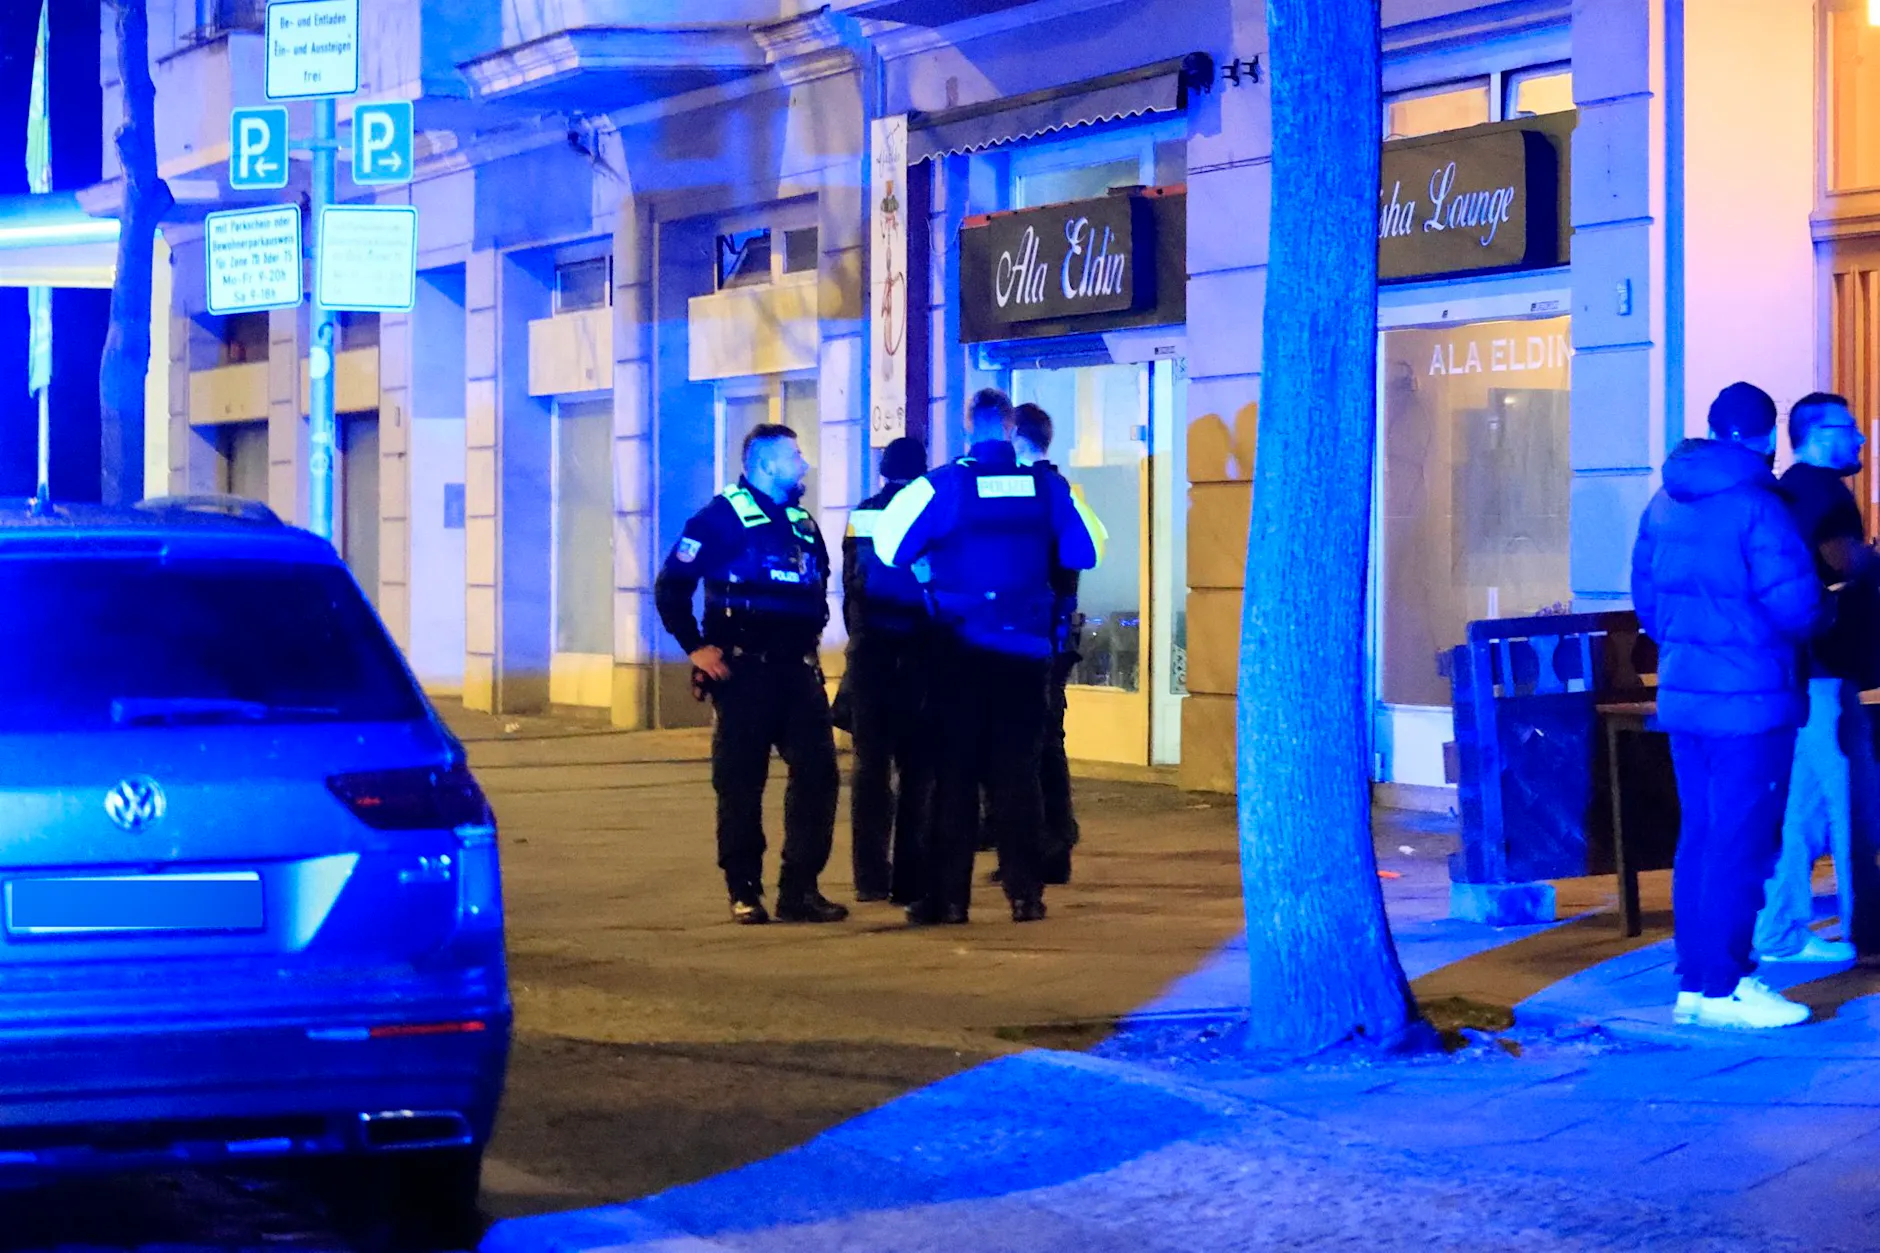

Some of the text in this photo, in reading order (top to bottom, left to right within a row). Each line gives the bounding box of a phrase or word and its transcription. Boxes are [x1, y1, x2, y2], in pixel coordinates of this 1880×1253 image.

[280, 12, 347, 29] Be- und Entladen
[274, 39, 351, 57] Ein- und Aussteigen
[303, 70, 322, 83] frei
[239, 117, 270, 178] P
[362, 111, 394, 173] P
[1423, 161, 1515, 247] Lounge
[215, 223, 227, 234] mit
[274, 216, 290, 228] oder
[230, 256, 248, 268] Zone
[996, 216, 1125, 308] Ala Eldin
[1429, 333, 1570, 376] ALA ELDIN
